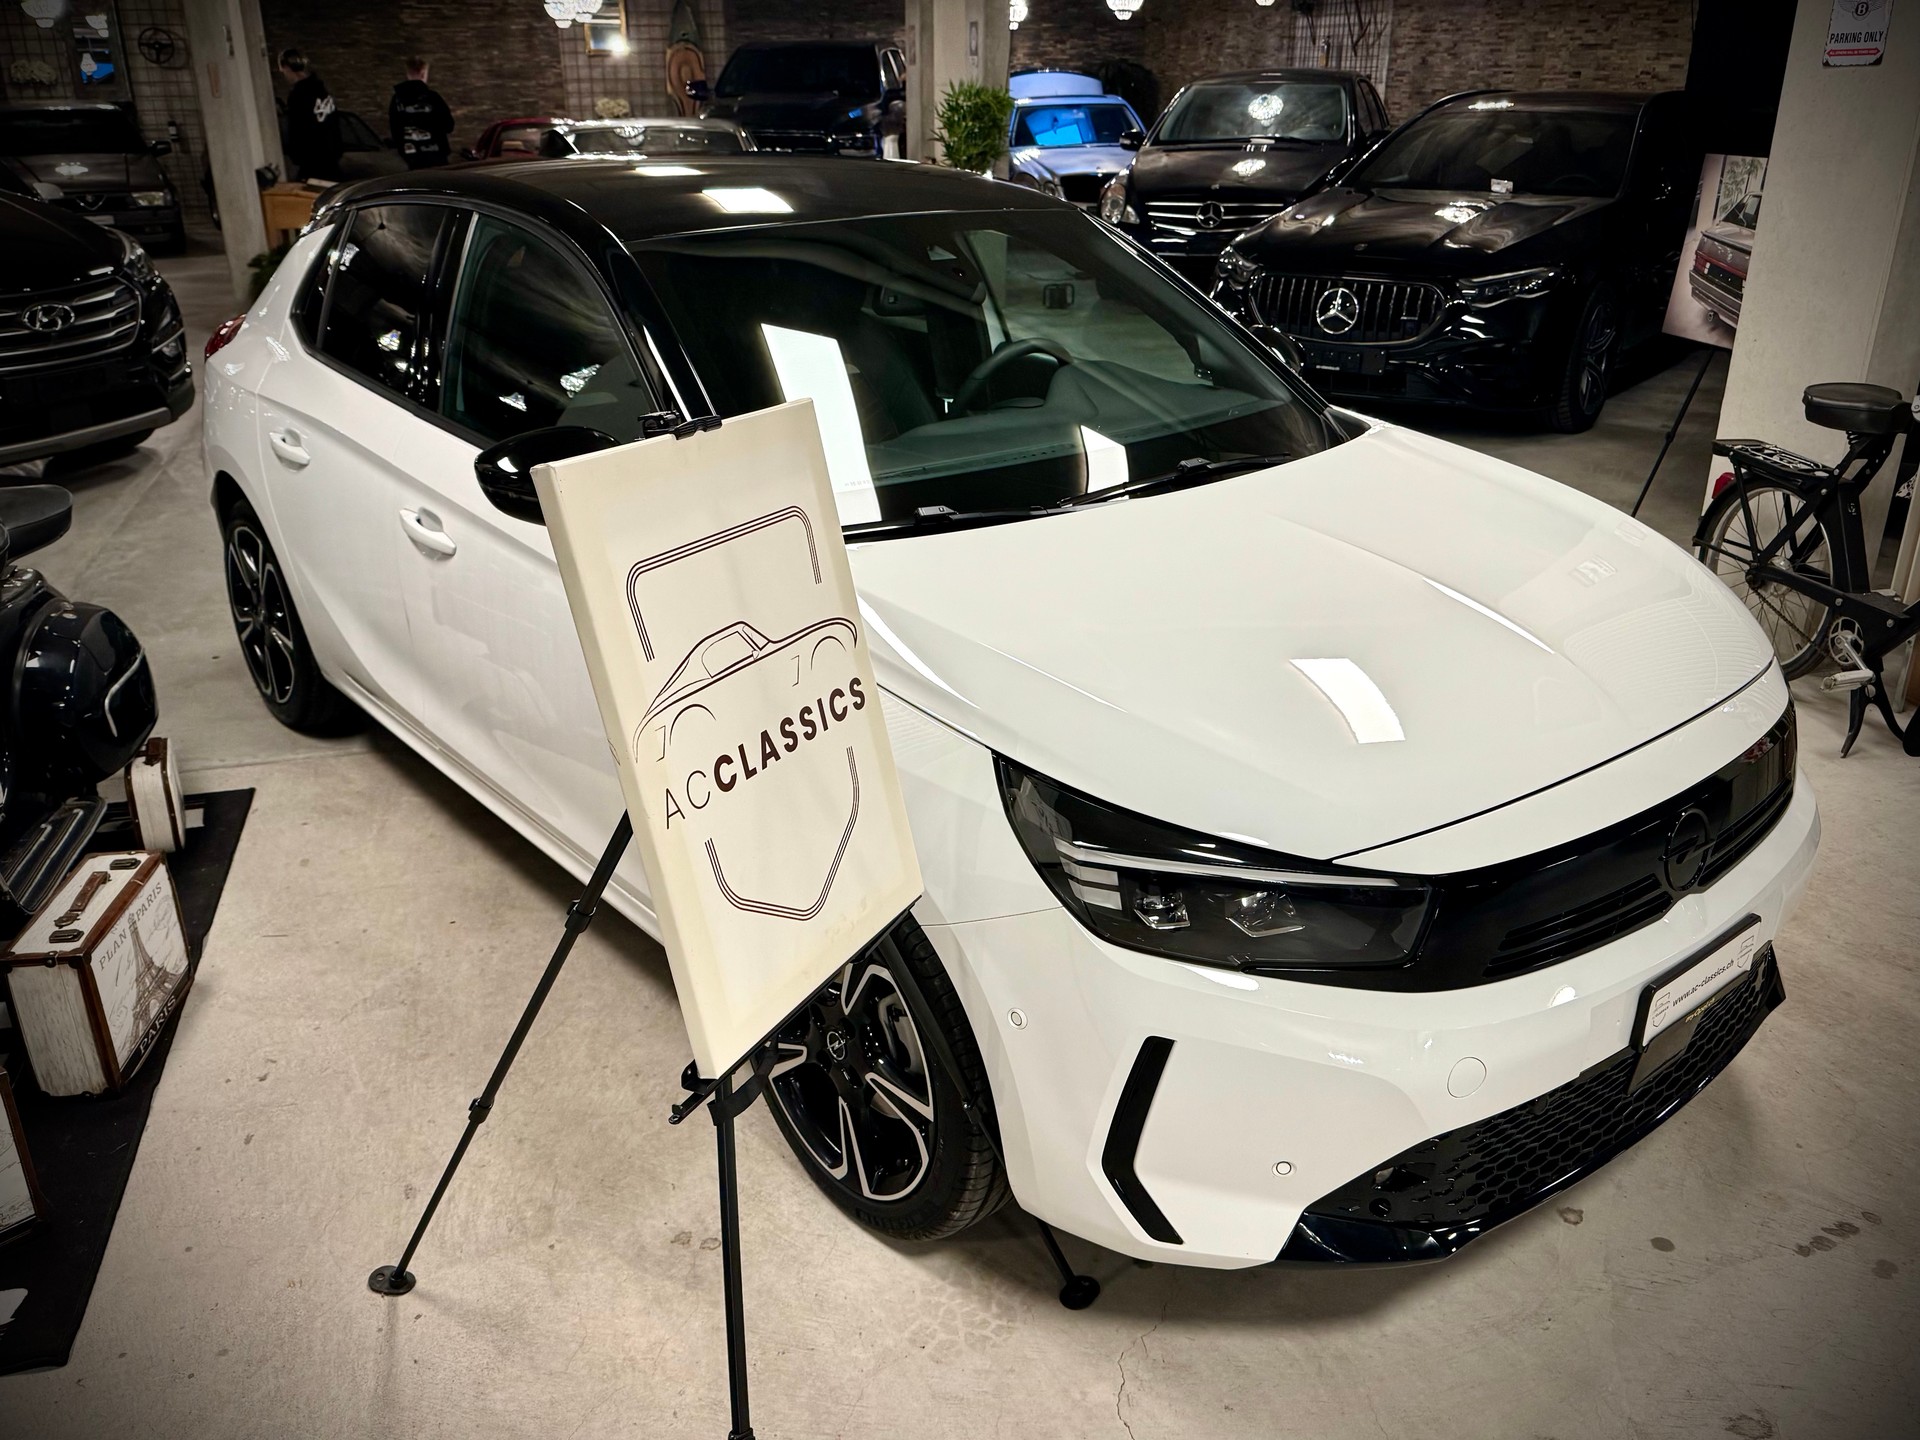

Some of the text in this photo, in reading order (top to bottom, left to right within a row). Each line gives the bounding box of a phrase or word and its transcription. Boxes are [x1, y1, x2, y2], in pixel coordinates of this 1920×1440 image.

[1829, 31, 1884, 44] PARKING ONLY
[99, 930, 128, 971] PLAN
[135, 882, 163, 922] PARIS
[1672, 959, 1735, 1007] www.ac-classics.ch
[139, 995, 177, 1055] PARIS
